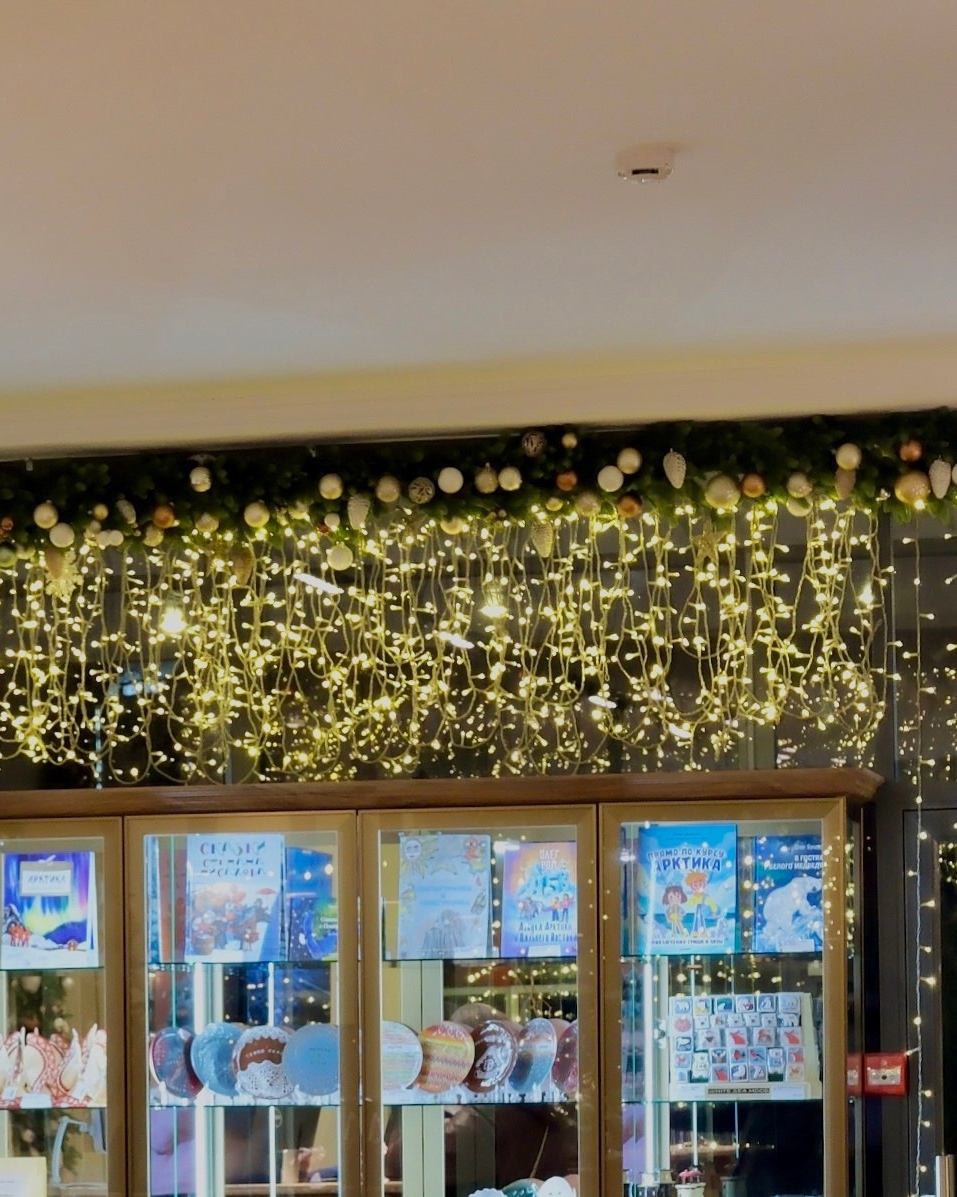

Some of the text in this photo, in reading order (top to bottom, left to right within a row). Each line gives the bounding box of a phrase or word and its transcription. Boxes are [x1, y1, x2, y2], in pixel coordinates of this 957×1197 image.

[682, 848, 693, 856] ПО
[696, 848, 724, 858] КУРСУ
[655, 857, 721, 871] АРКТИКА
[28, 875, 66, 885] АРКТИКА
